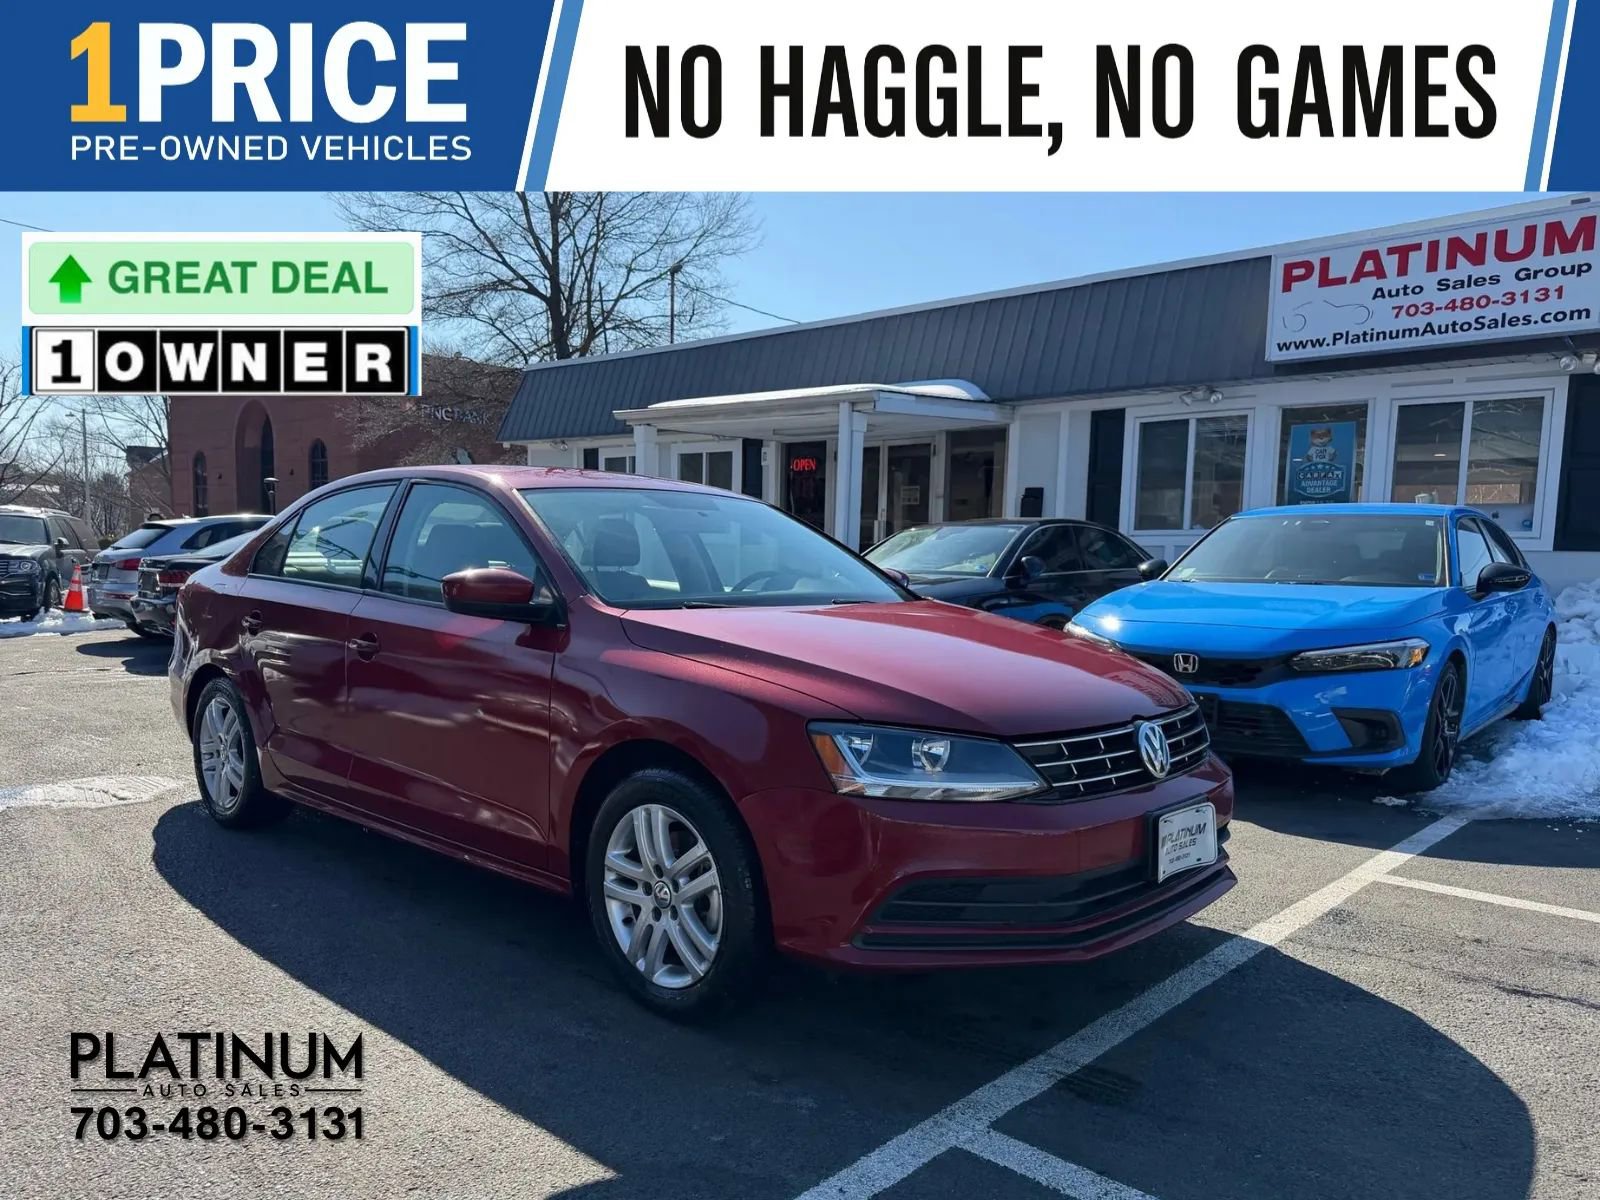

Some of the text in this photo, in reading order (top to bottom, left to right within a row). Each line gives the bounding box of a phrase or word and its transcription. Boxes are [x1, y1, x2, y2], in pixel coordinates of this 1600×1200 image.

[1281, 214, 1598, 293] PLATINUM
[1371, 261, 1593, 300] Auto Sales Group
[1391, 285, 1565, 319] 703-480-3131
[1276, 306, 1592, 352] www.PlatinumAutoSales.com
[793, 457, 816, 472] OPEN
